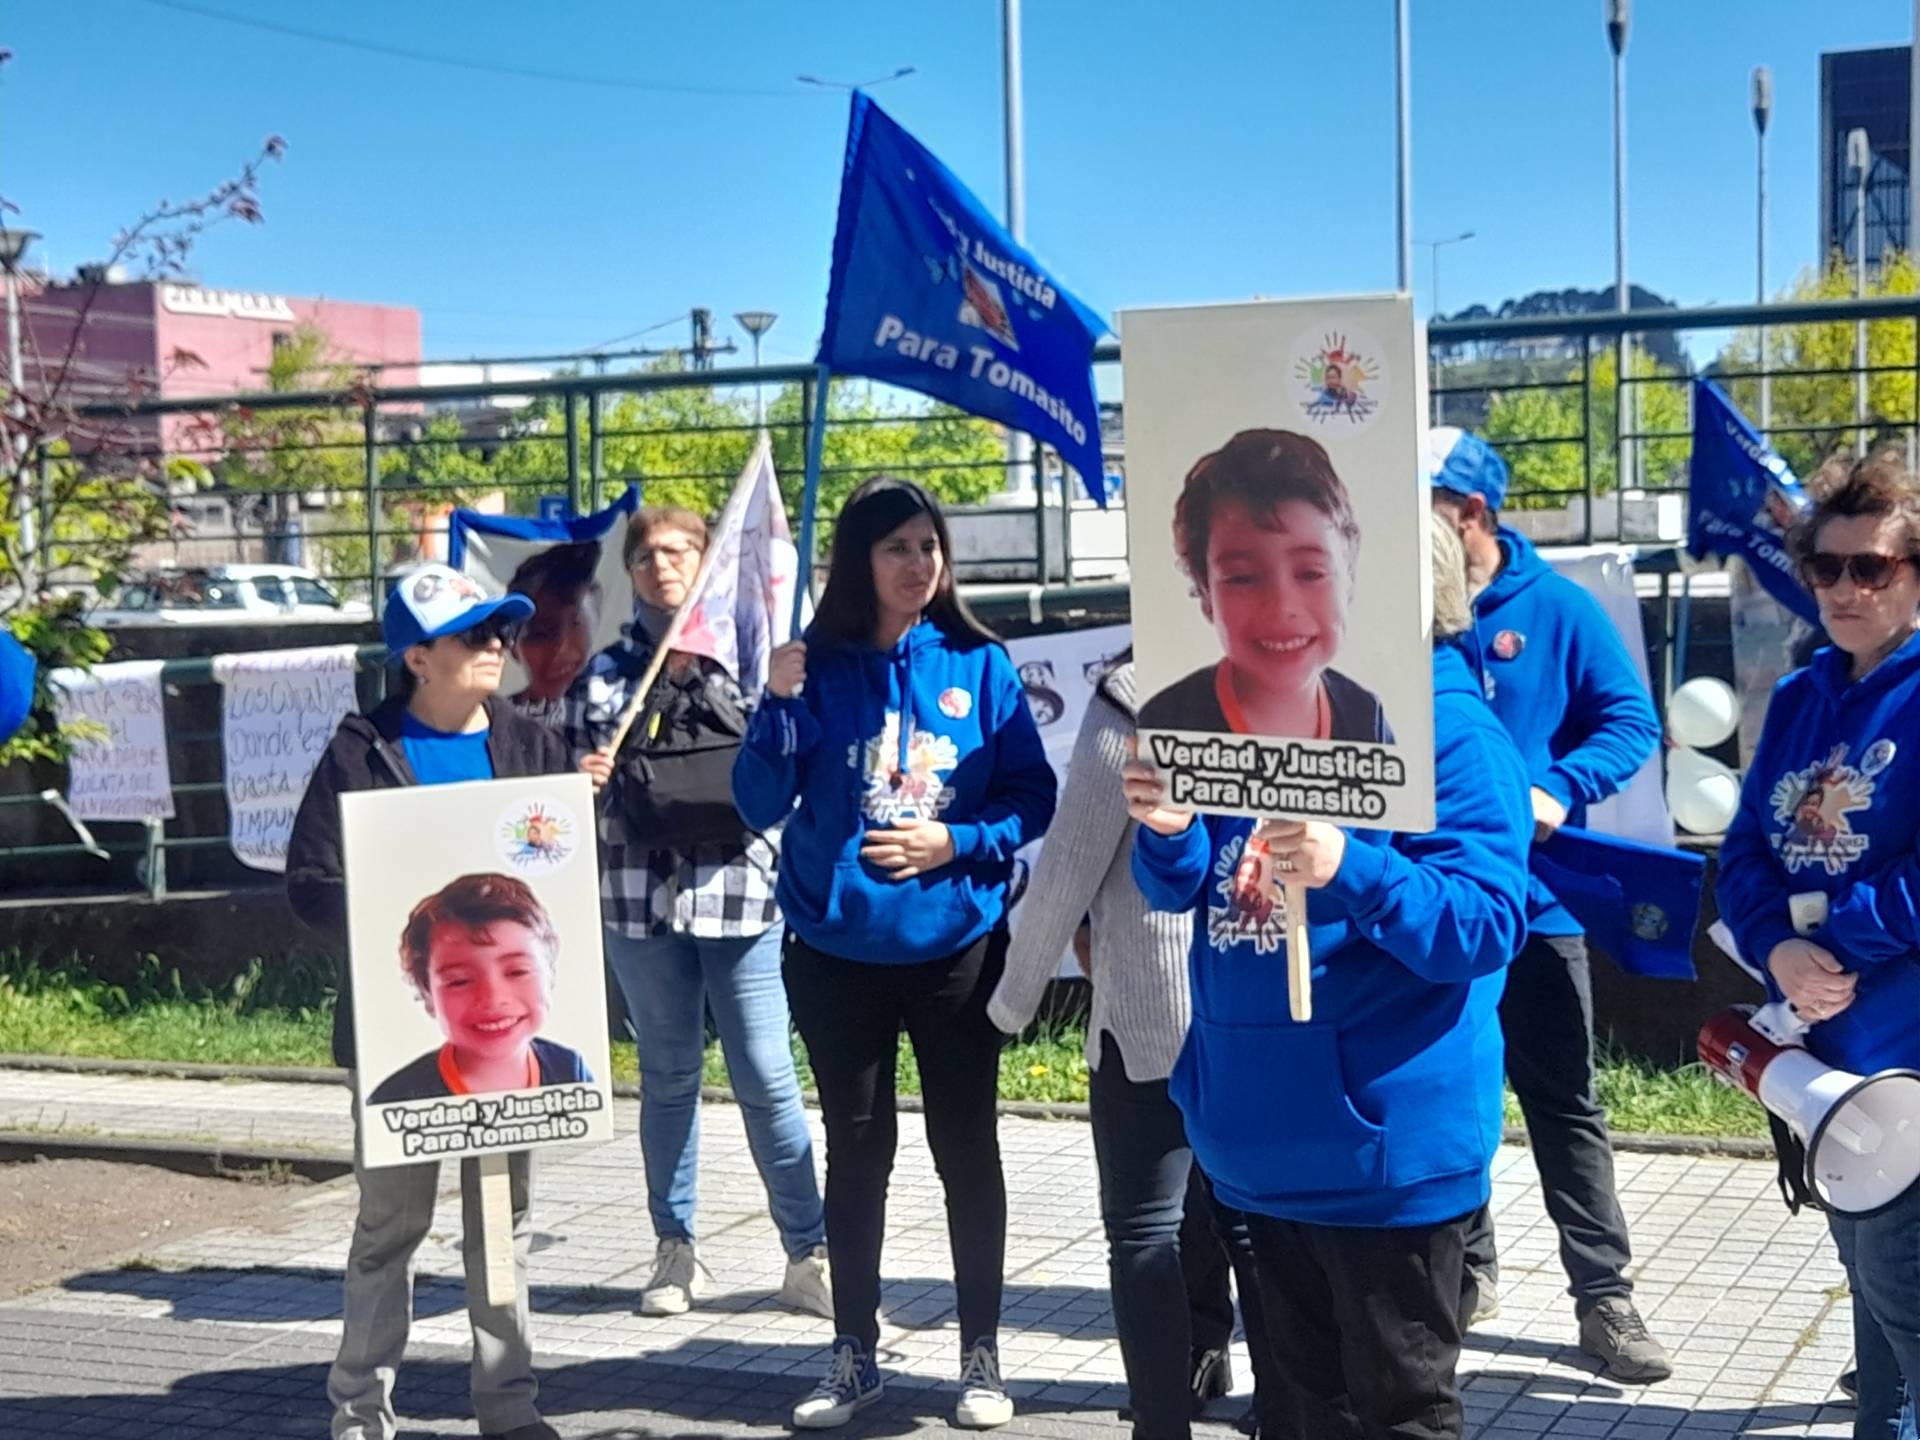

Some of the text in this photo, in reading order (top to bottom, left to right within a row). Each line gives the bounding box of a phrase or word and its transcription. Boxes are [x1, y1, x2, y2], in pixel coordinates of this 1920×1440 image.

[973, 240, 1057, 310] Justicia
[874, 315, 1088, 447] Para Tomasito
[1697, 510, 1794, 574] Para Tom
[230, 720, 295, 765] Donde
[1152, 735, 1403, 785] Verdad y Justicia
[231, 762, 291, 804] Basta
[1174, 771, 1384, 818] Para Tomasito
[384, 1087, 602, 1132] Verdad y Justicia
[403, 1117, 588, 1156] Para Tomasito
